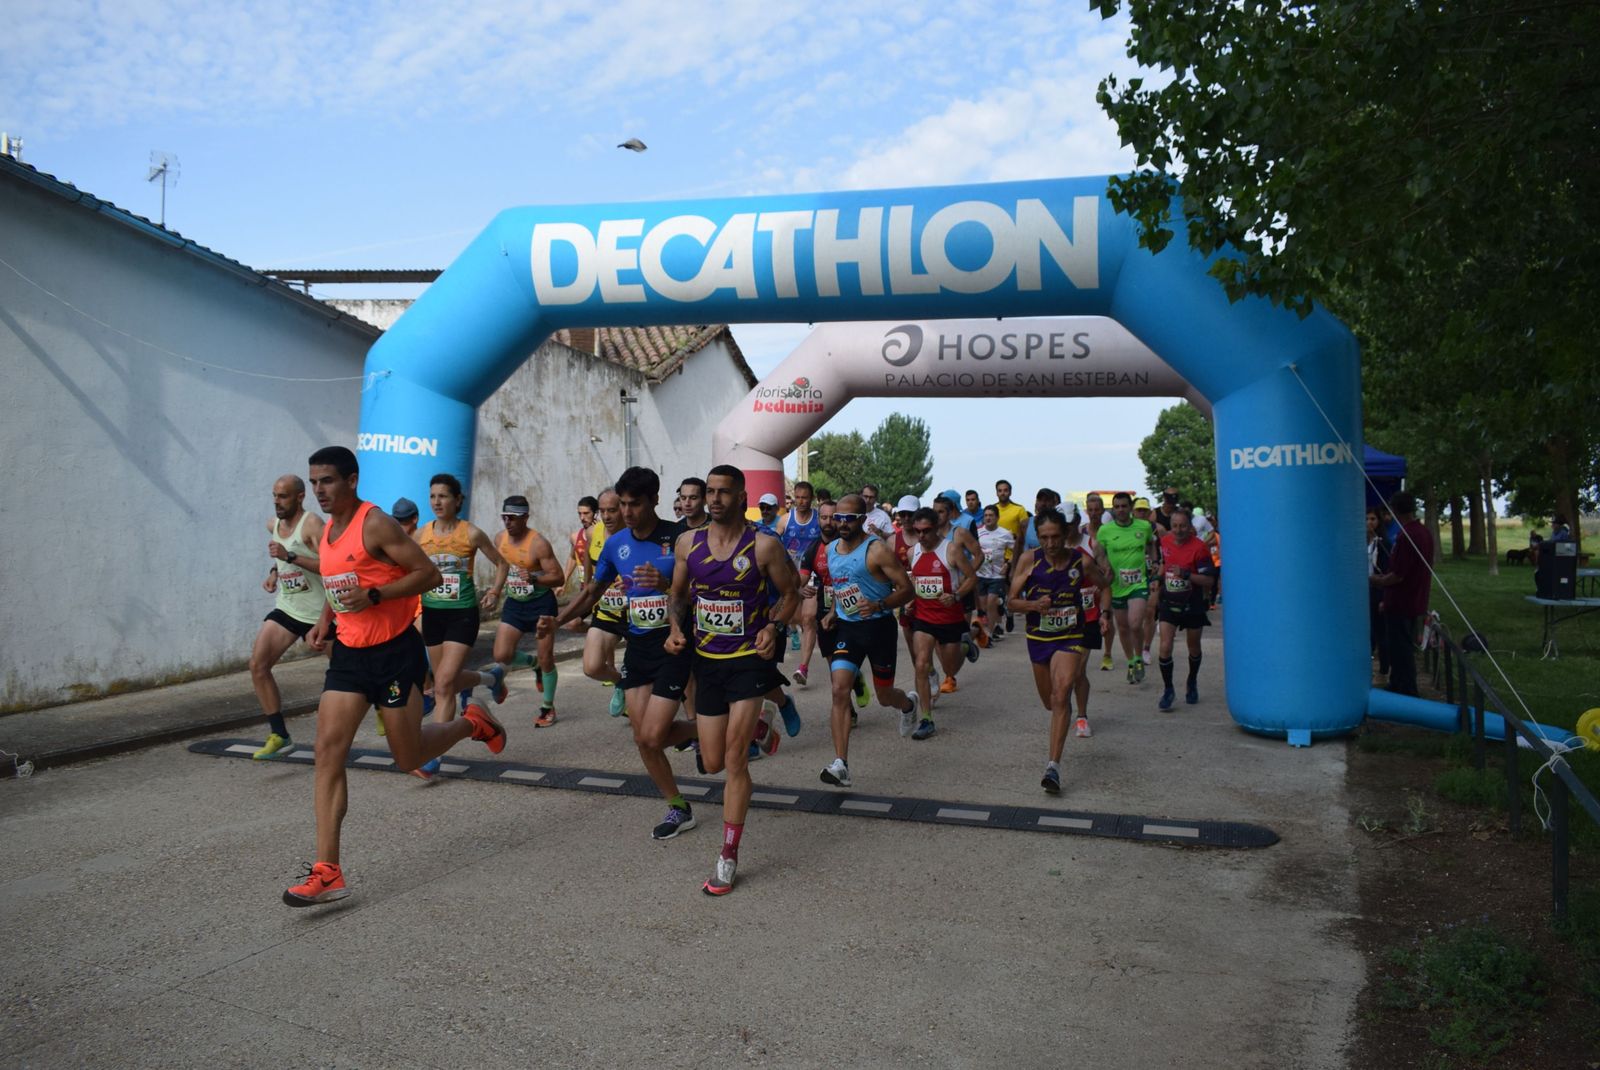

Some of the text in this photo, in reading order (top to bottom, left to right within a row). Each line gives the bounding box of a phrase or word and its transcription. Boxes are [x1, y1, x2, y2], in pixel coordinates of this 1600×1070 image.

[531, 195, 1099, 306] DECATHLON
[938, 332, 1091, 361] HOSPES
[885, 371, 1149, 388] PALACIO DE SAN ESTEBAN
[1230, 442, 1353, 470] DECATHLON
[511, 586, 529, 594] 375
[920, 585, 938, 594] 363
[604, 597, 623, 606] 310
[638, 608, 665, 621] 369
[705, 612, 734, 627] 424
[1048, 616, 1069, 627] 301
